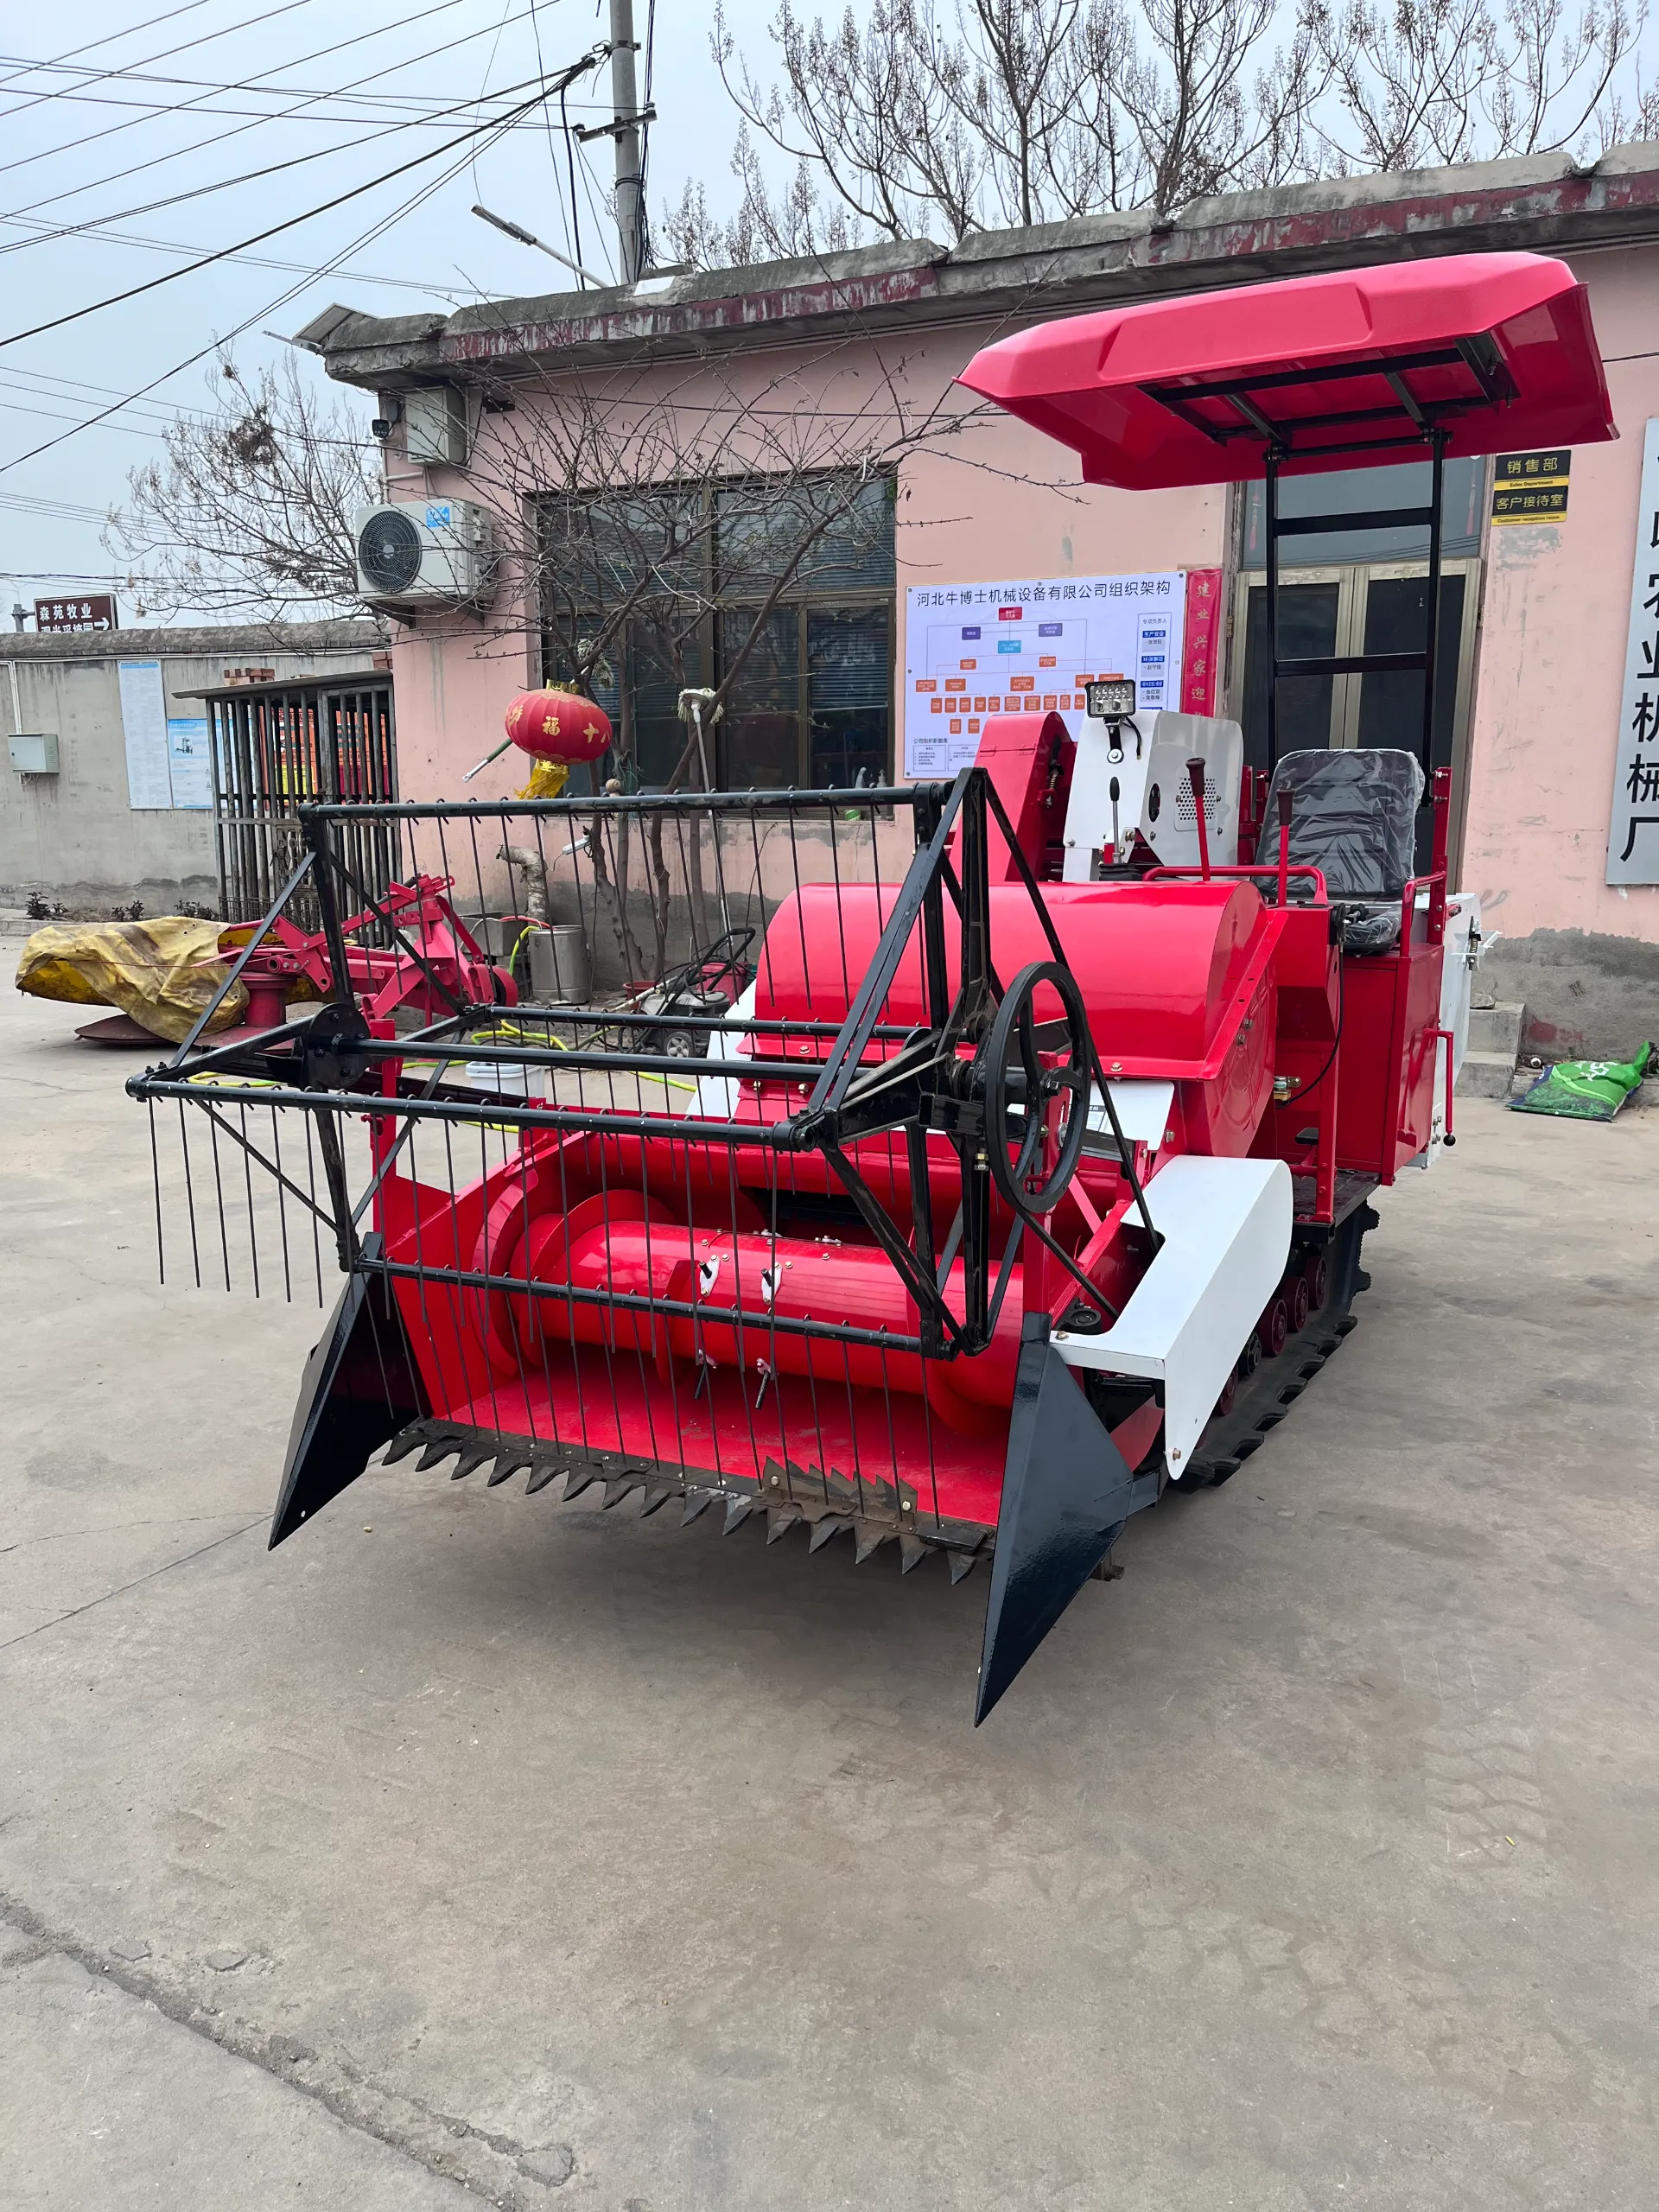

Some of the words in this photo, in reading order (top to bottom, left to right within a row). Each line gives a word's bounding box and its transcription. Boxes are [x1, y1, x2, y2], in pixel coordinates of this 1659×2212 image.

[1507, 457, 1558, 474] 销售部
[1496, 493, 1564, 510] 客户接待室
[918, 580, 1171, 607] 河北牛博士机械设备有限公司组织架构
[39, 602, 92, 622] 森苑牧业
[1191, 580, 1211, 716] 建业兴家迎
